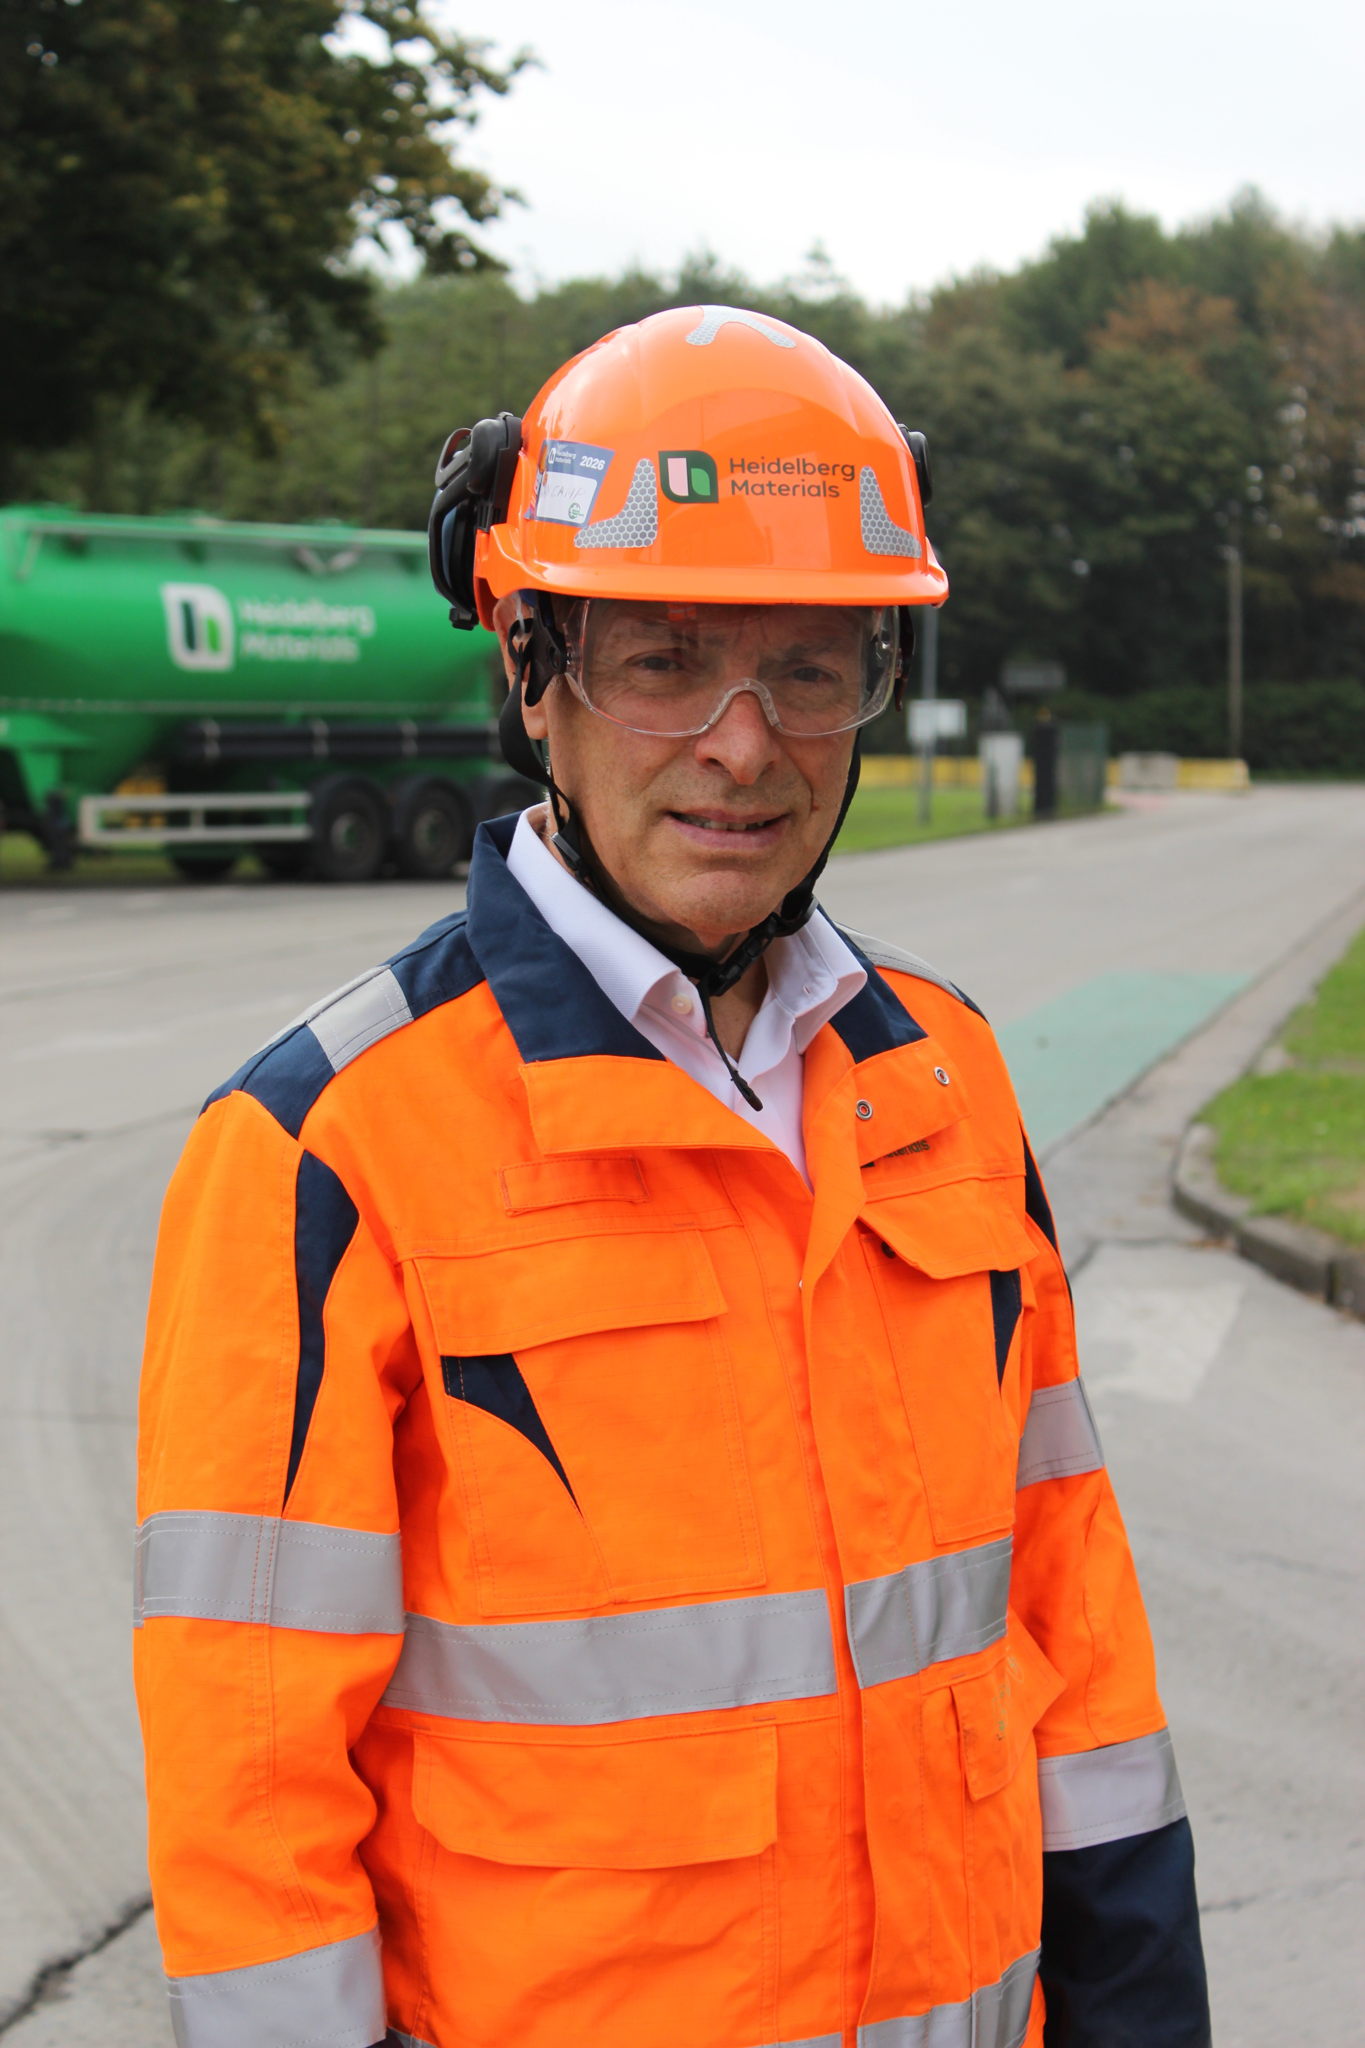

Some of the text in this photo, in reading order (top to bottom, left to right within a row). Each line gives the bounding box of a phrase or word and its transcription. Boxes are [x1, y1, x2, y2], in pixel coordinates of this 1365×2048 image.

[580, 456, 606, 471] 2026
[729, 456, 856, 482] Heidelberg
[731, 479, 841, 498] Materials
